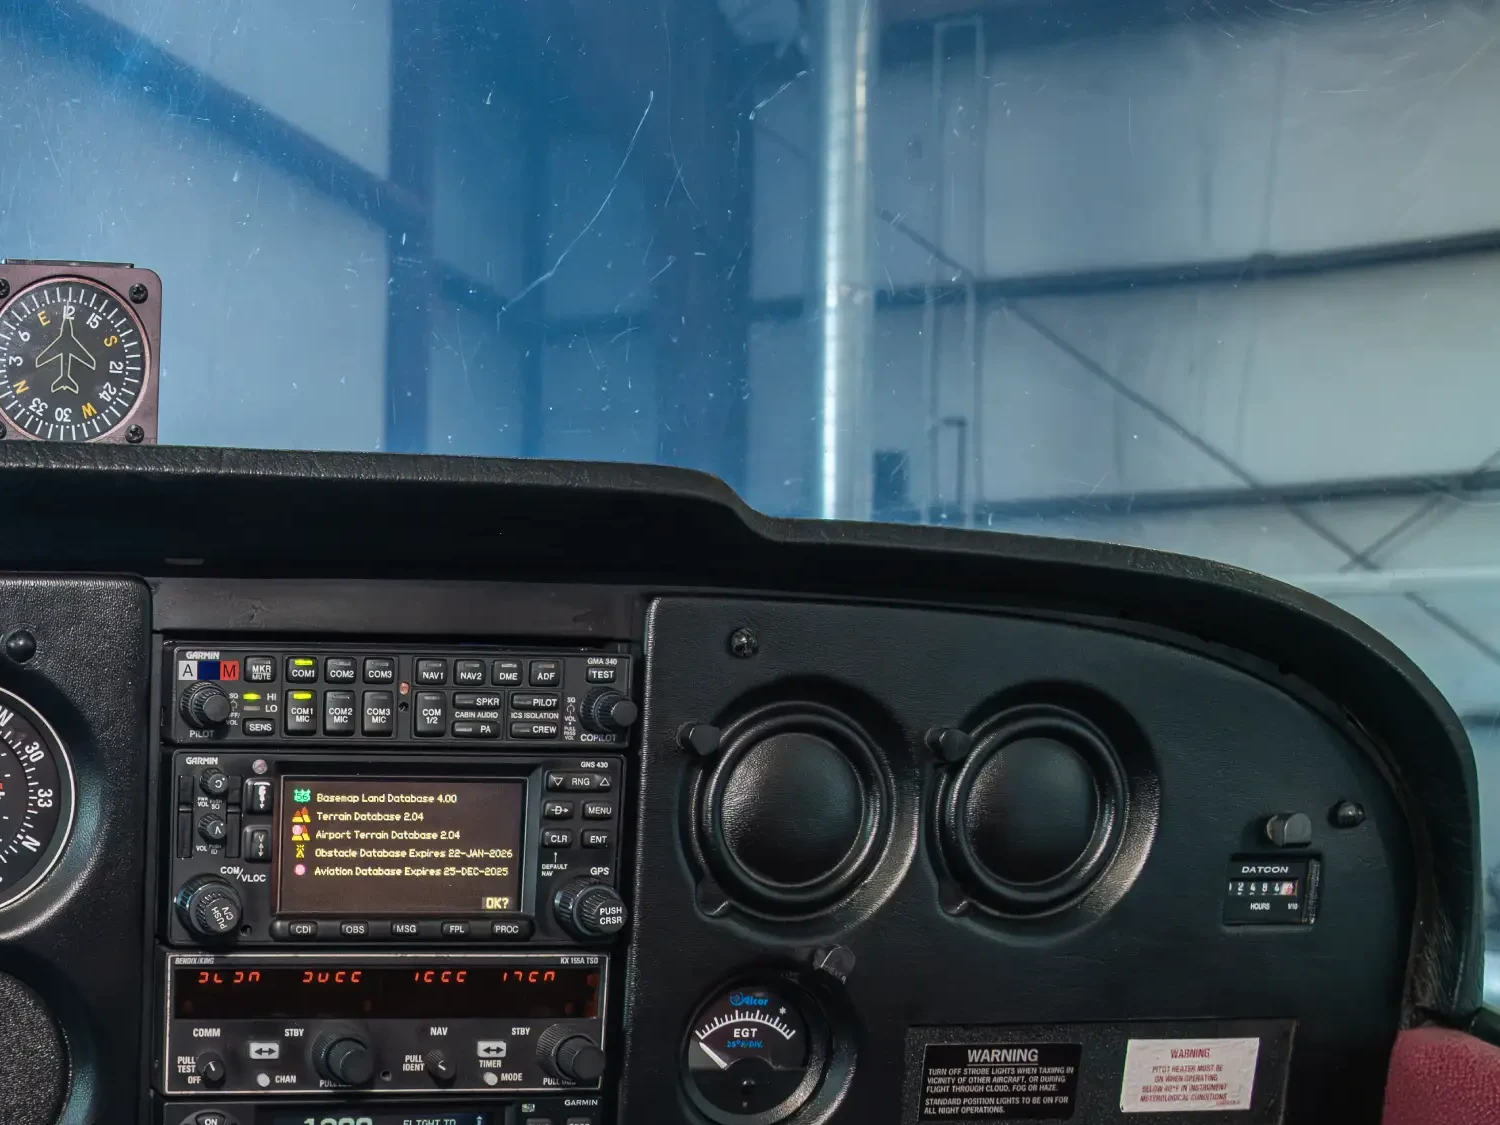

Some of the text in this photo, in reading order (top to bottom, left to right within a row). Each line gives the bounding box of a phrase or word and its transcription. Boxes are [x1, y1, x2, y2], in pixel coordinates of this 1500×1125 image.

[38, 310, 51, 326] E
[186, 652, 220, 660] GARMIN
[330, 670, 354, 678] COM2
[423, 672, 443, 680] NAV1
[592, 671, 614, 679] TEST
[476, 698, 499, 706] SPKR
[572, 778, 590, 786] RNG
[317, 794, 457, 803] Basemap Land Database 4.00
[588, 806, 612, 814] MENU
[317, 812, 424, 821] Terrain Database 2.04
[316, 831, 460, 840] Airport Terrain Database 2.04
[551, 835, 567, 843] CLR
[315, 849, 512, 859] Obstacle Database Expires 22-JAN-2026
[315, 867, 508, 877] Aviation Database Expires 25-DEC-2025
[590, 867, 610, 875] GPS
[486, 898, 509, 909] OK?
[600, 917, 622, 925] CRSR
[396, 925, 416, 933] MSG
[450, 925, 464, 933] FPL
[496, 925, 518, 933] PROC
[193, 1028, 220, 1037] COMM
[285, 1029, 304, 1037] STBY
[430, 1027, 448, 1036] NAV
[511, 1027, 530, 1036] STBY
[733, 1028, 757, 1038] EGT
[967, 1049, 1039, 1063] WARNING
[1170, 1048, 1211, 1059] WARNING
[479, 1060, 502, 1068] TIMER
[275, 1075, 296, 1083] CHAN
[501, 1073, 523, 1081] MODE
